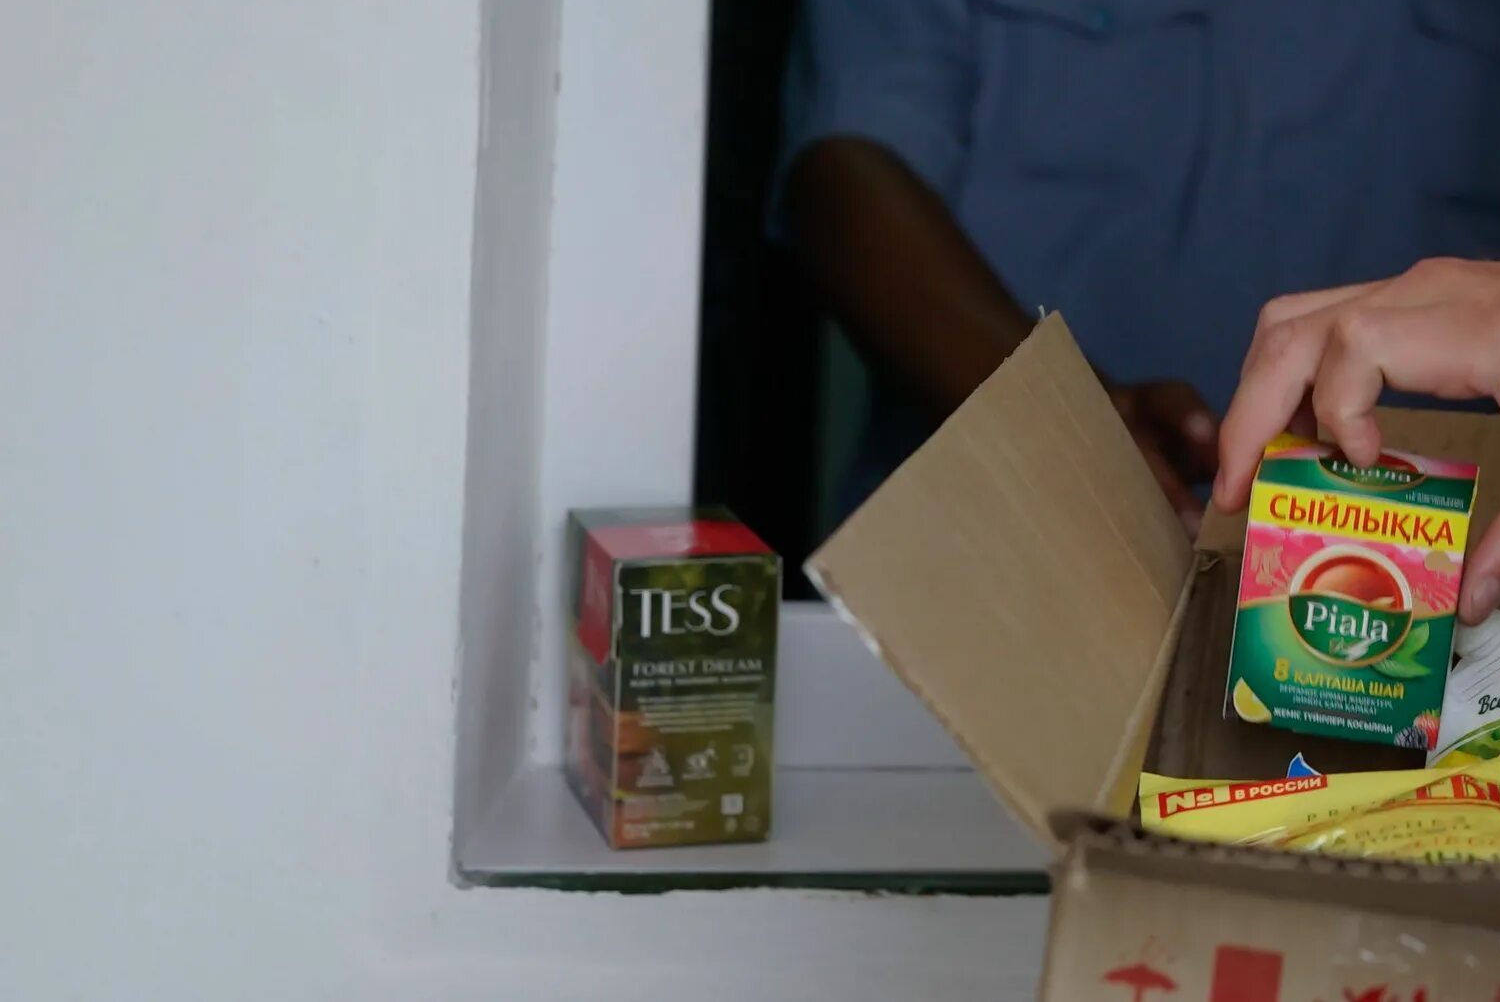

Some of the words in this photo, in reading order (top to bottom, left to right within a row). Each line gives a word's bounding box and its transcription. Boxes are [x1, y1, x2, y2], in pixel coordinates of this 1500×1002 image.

[1269, 493, 1454, 546] СЫЙЛЫҚҚА
[629, 583, 742, 638] TESS
[1304, 600, 1389, 643] Piala
[1273, 657, 1290, 683] 8
[1234, 788, 1246, 800] В
[1249, 776, 1322, 799] РОССИИ
